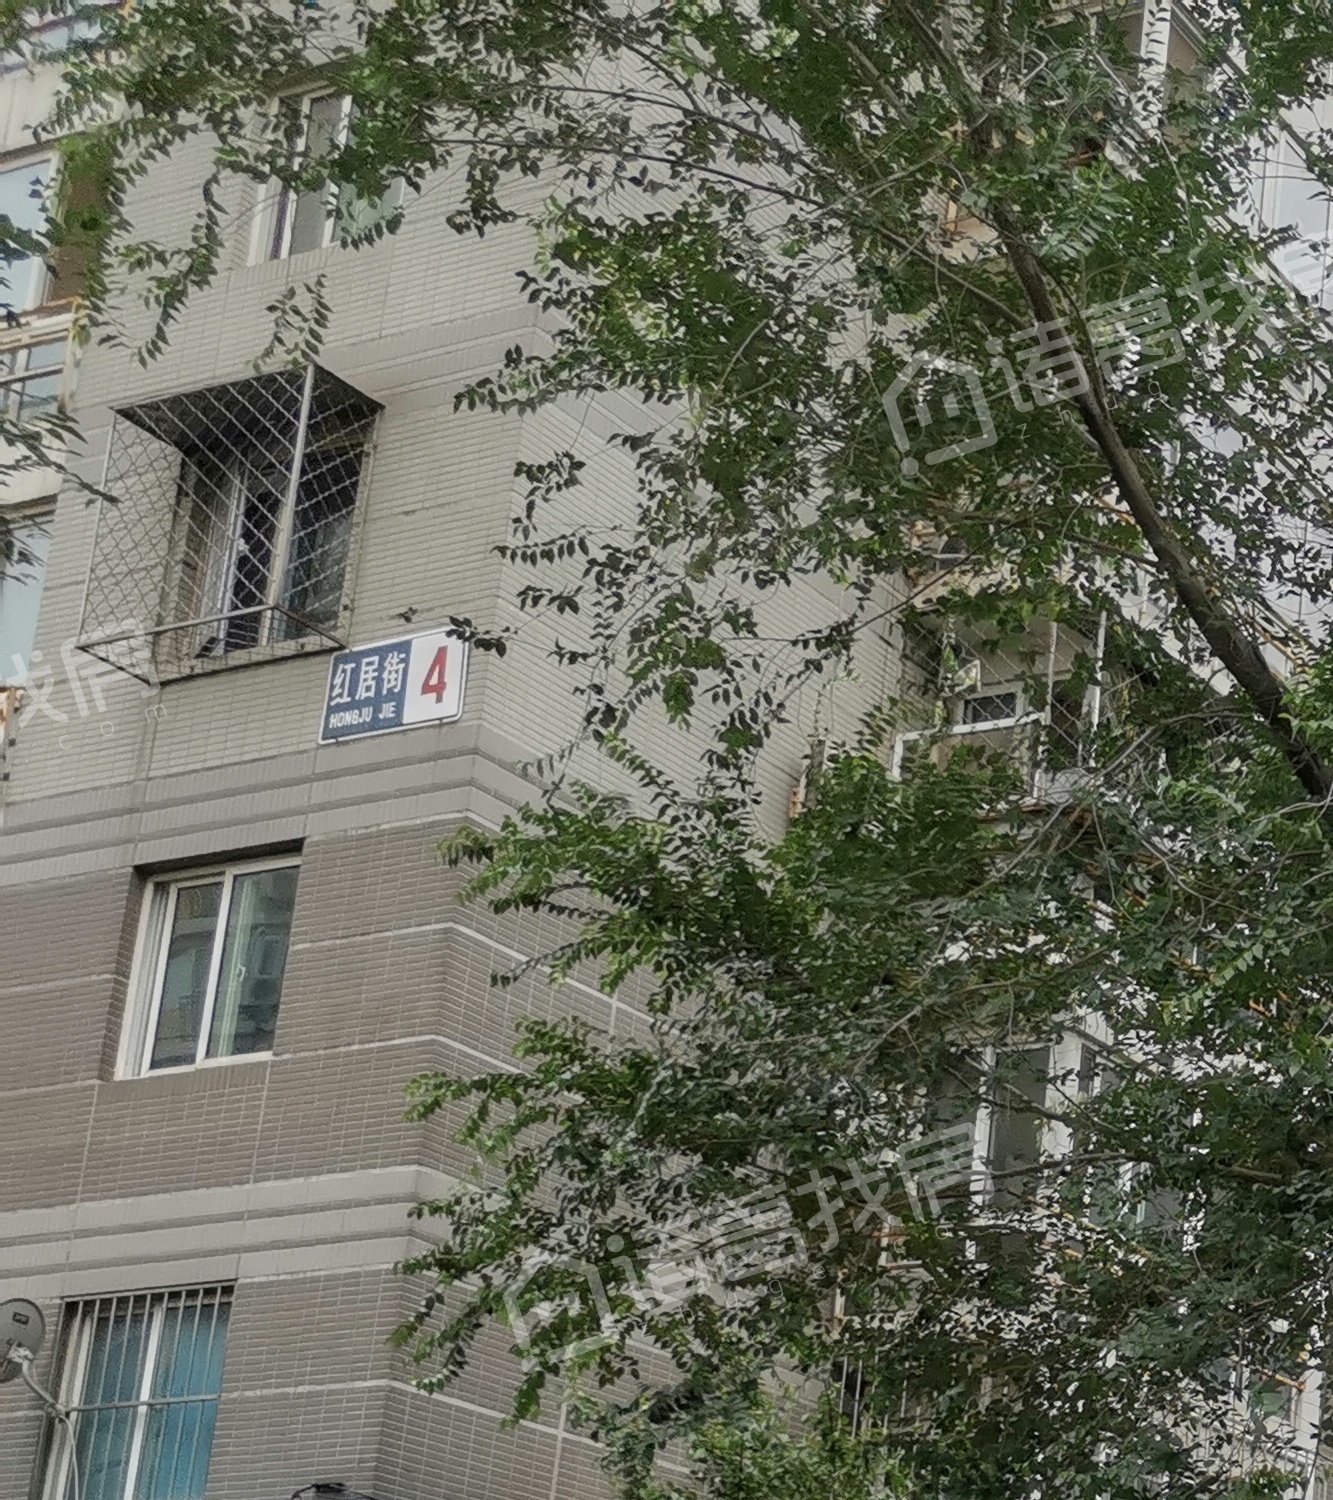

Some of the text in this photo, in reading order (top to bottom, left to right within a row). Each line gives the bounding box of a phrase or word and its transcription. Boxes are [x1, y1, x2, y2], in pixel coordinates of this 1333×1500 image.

[330, 651, 406, 706] 红居街
[420, 645, 448, 704] 4
[329, 702, 397, 729] HONGJU JIE
